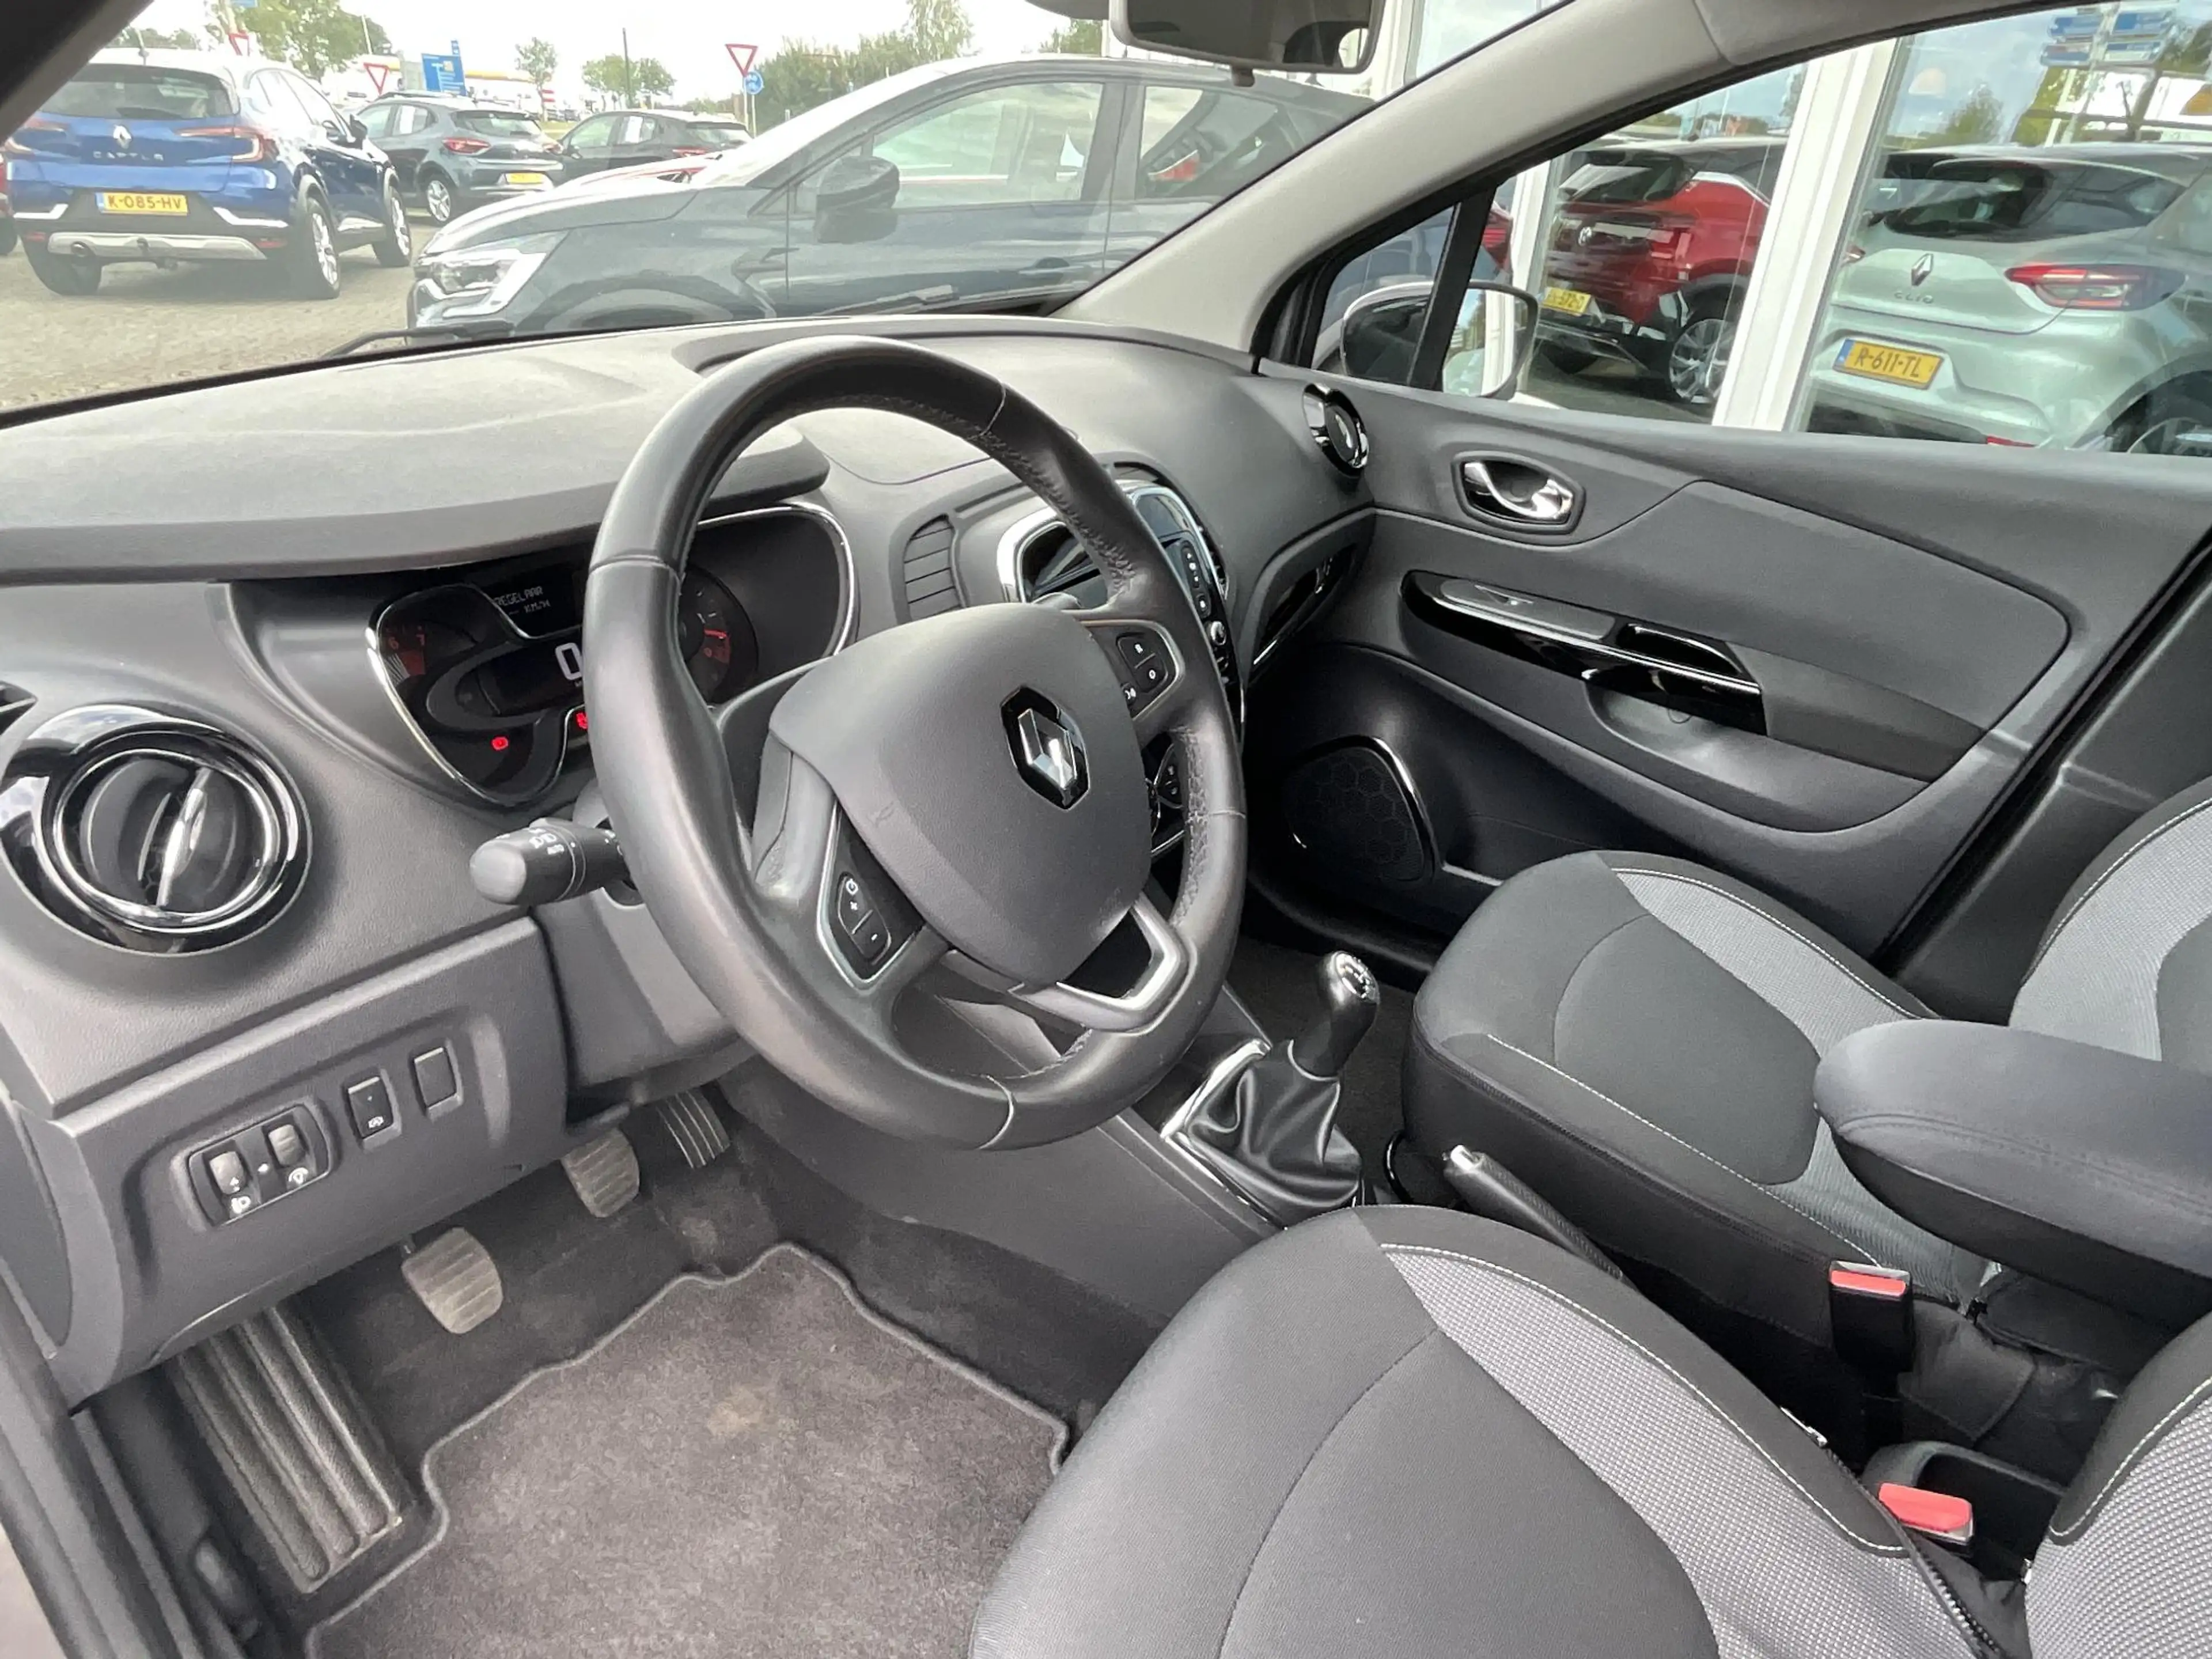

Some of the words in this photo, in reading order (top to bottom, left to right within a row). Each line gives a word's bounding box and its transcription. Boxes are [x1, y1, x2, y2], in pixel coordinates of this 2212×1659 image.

[108, 195, 182, 209] K-085-HV
[1894, 291, 1934, 304] CLIO
[1854, 347, 1922, 378] R-611-TL
